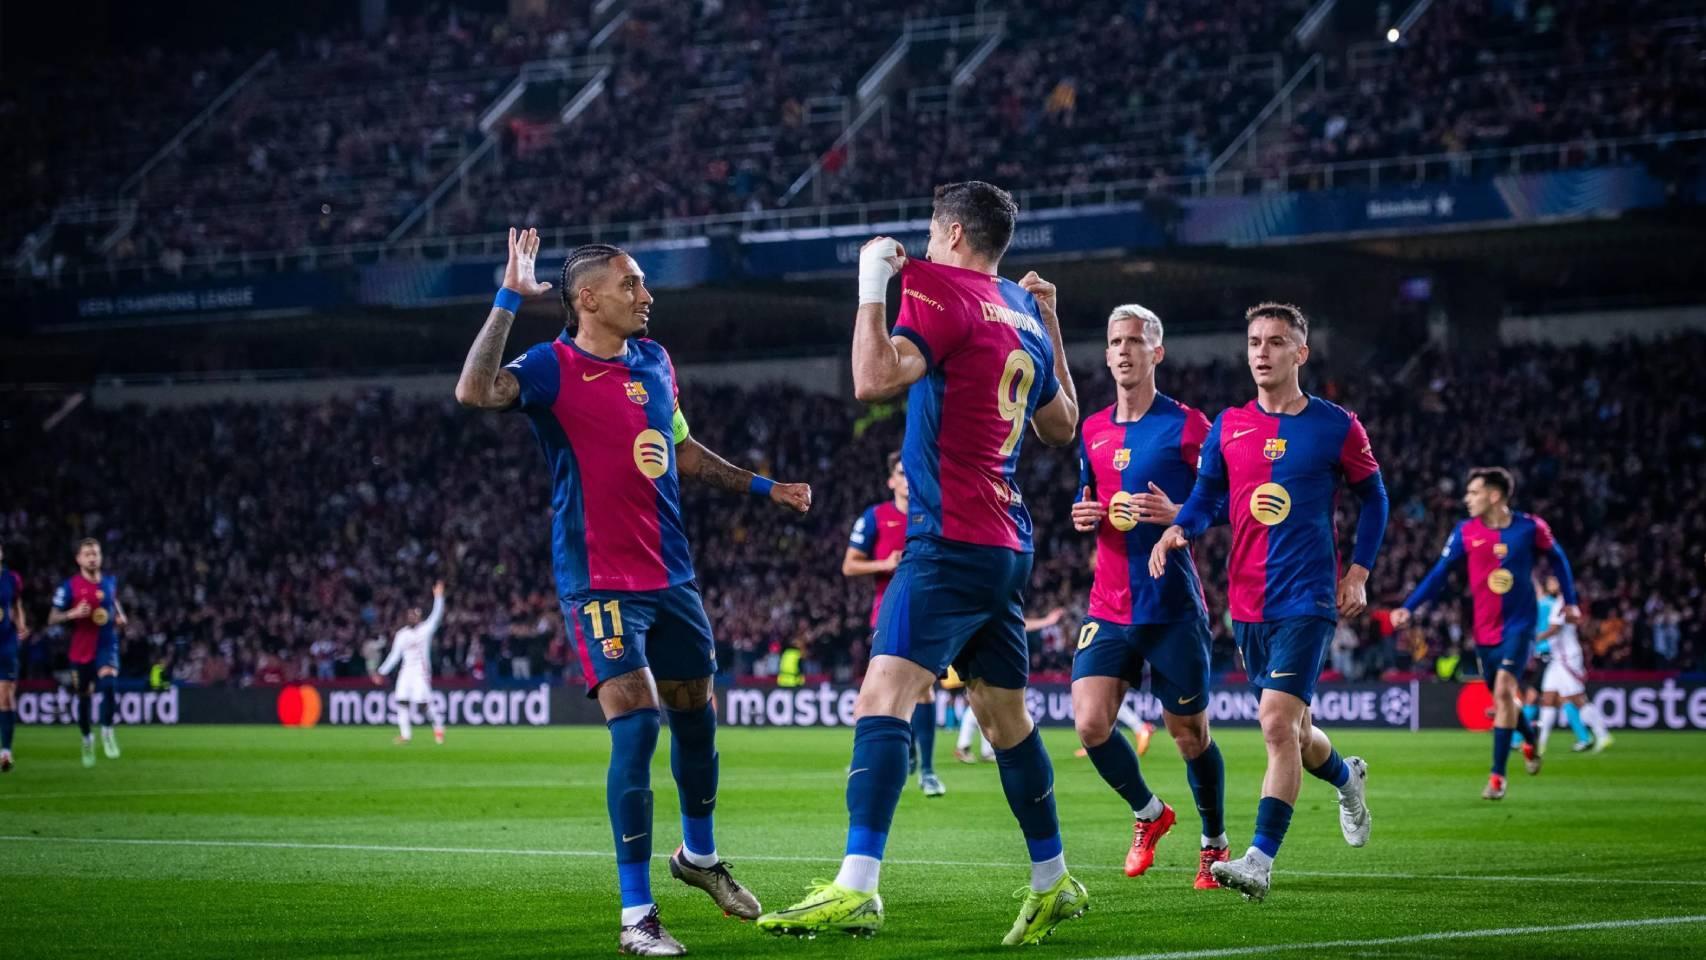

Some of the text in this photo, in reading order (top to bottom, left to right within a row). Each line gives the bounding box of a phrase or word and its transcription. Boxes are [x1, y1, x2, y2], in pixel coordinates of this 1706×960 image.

[998, 349, 1035, 456] 9
[584, 600, 624, 638] 11
[18, 685, 179, 724] astrard
[1310, 691, 1376, 721] AGUE
[1593, 678, 1706, 729] aste
